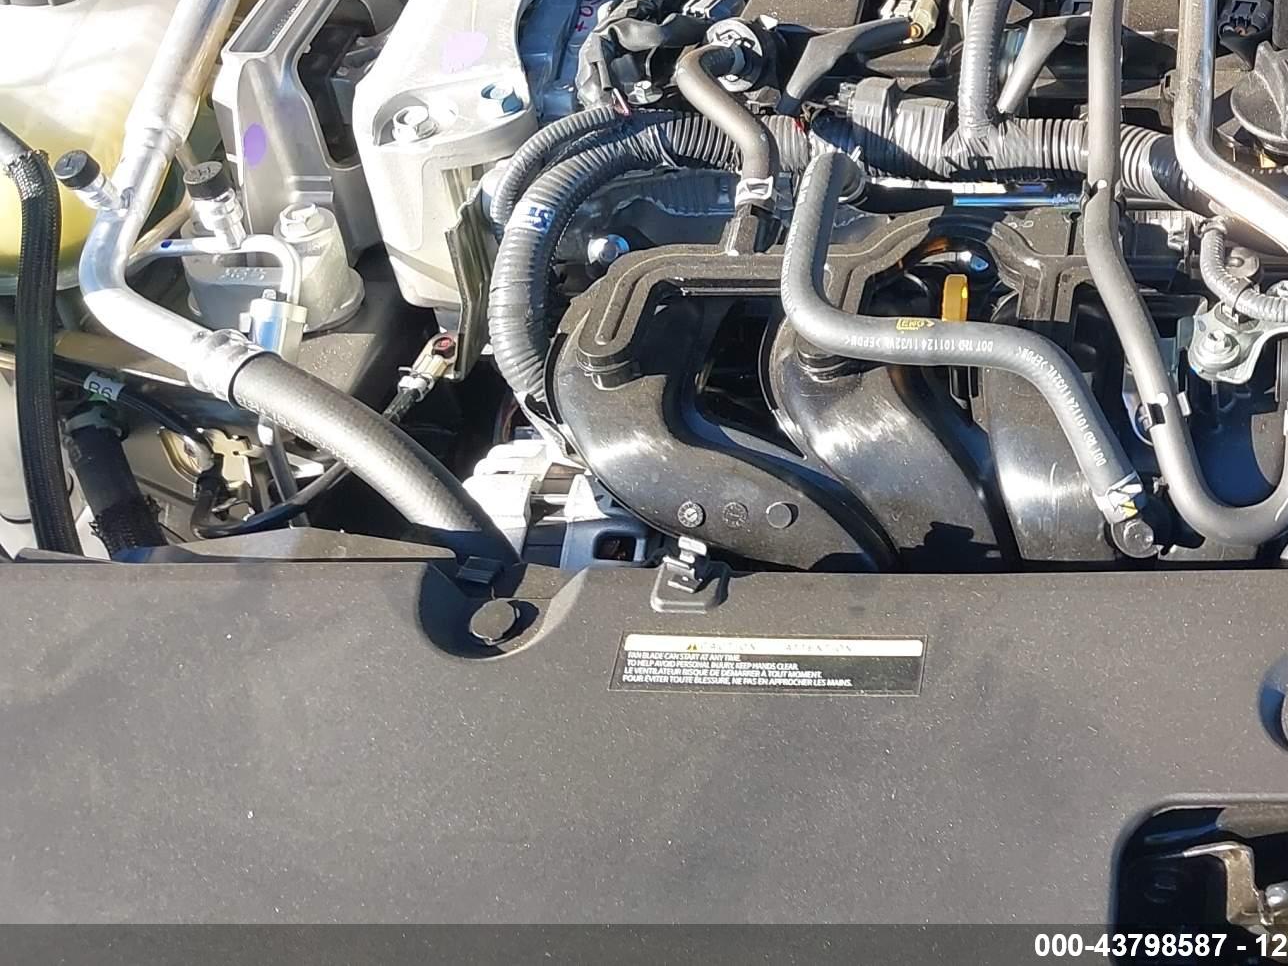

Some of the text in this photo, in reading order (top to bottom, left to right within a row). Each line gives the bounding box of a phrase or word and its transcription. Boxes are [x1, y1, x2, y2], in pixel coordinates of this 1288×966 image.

[922, 338, 955, 351] 101124
[1068, 397, 1090, 432] 101124
[642, 652, 663, 660] BLADE
[676, 661, 710, 669] PERSONAL
[634, 667, 682, 676] VENTILATEUR
[682, 669, 710, 677] RISQUE
[769, 678, 813, 686] APPROCHER
